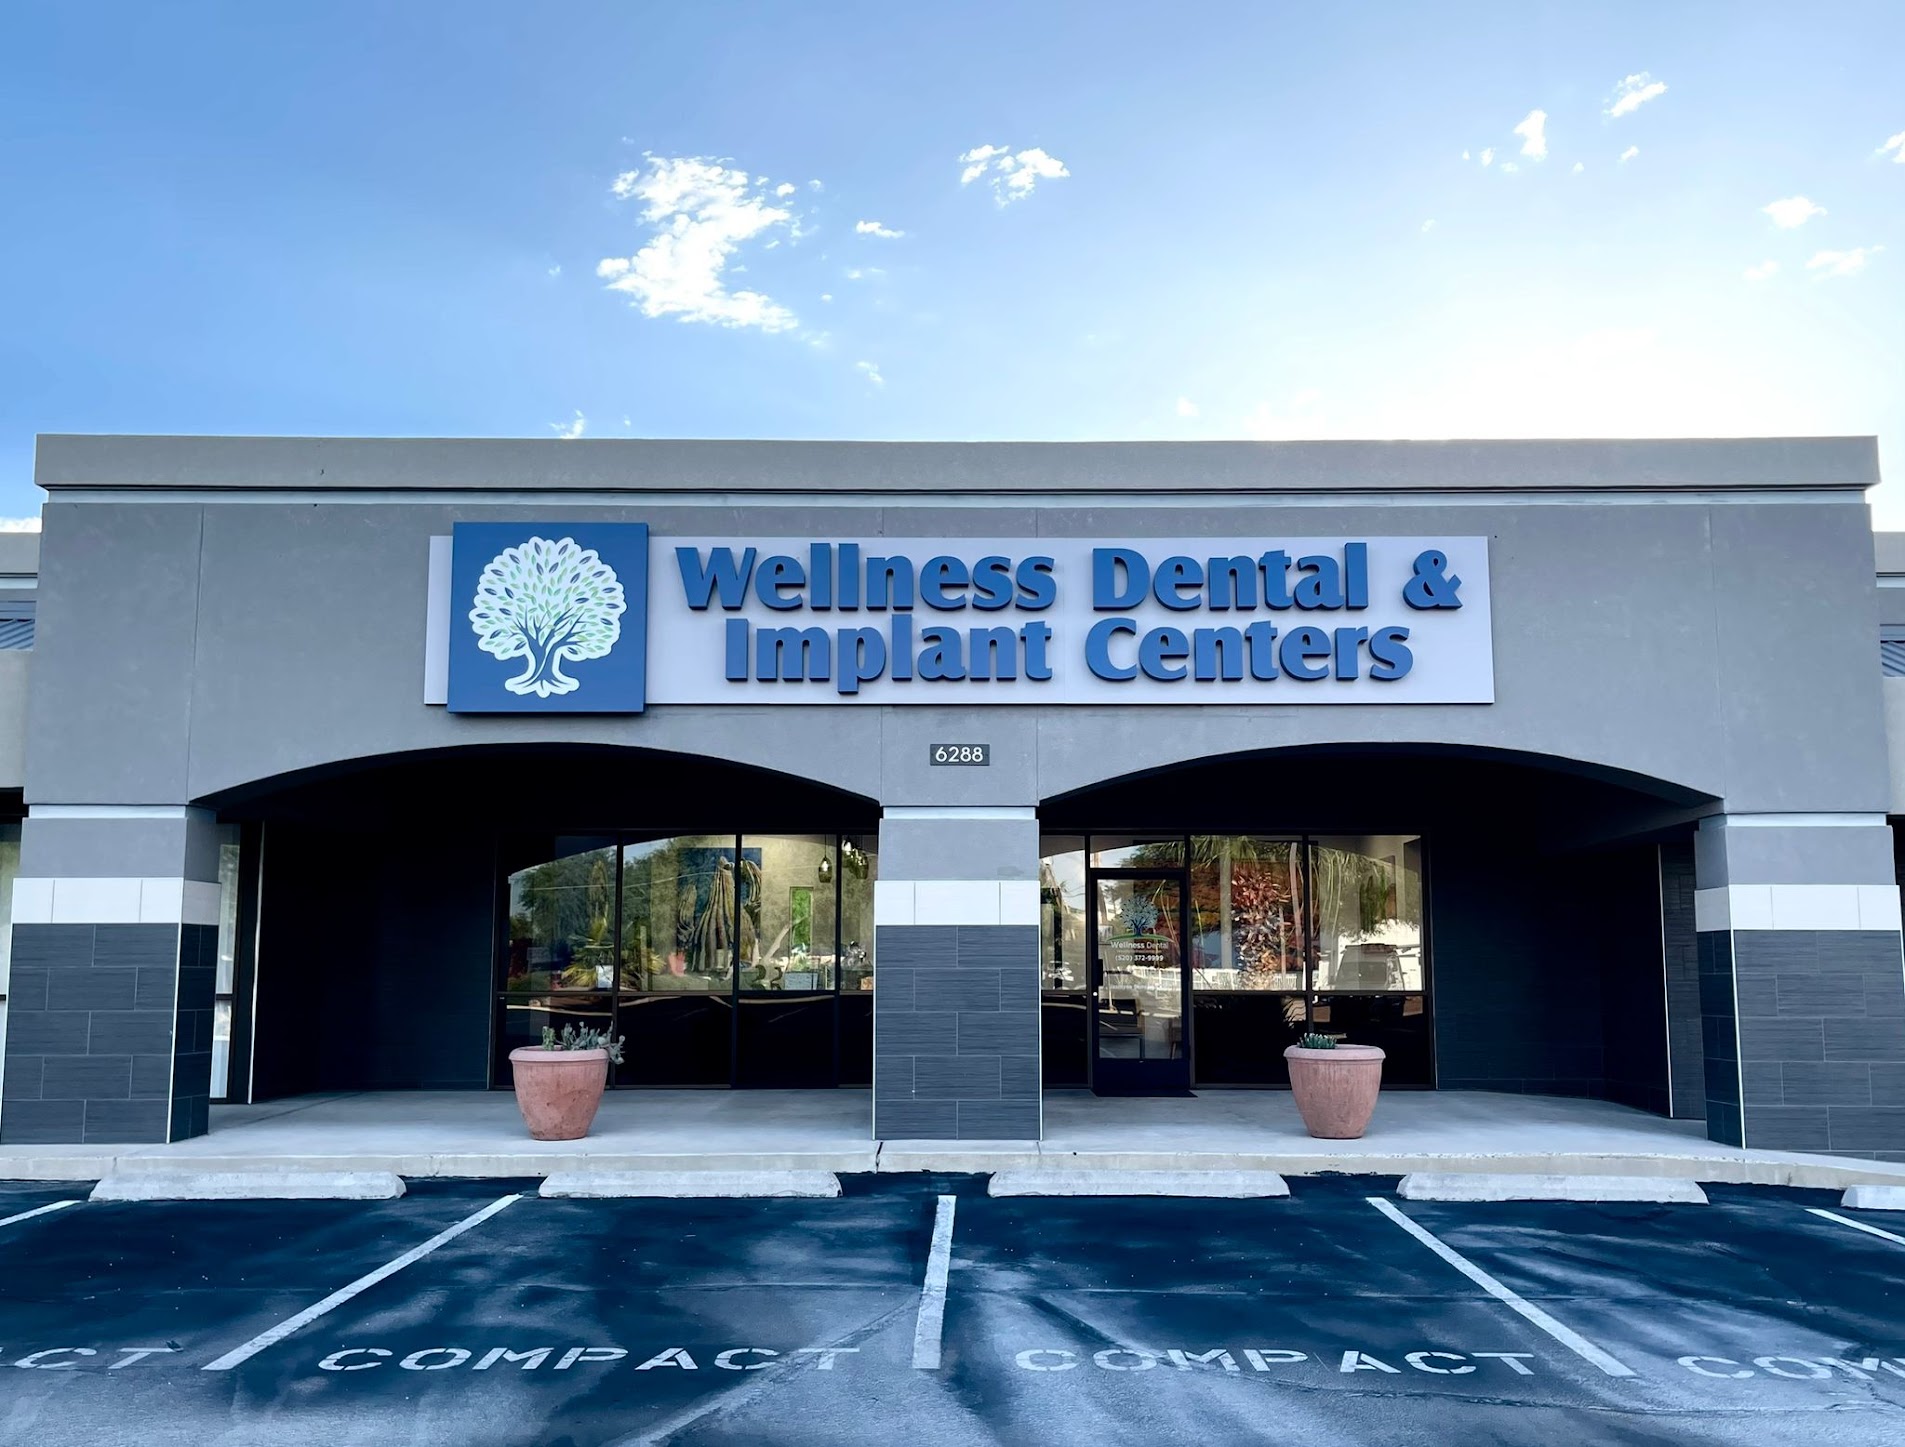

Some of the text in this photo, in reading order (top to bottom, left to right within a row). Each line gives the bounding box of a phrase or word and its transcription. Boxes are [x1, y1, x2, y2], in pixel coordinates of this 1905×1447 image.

[675, 542, 1463, 611] Wellness Dental &
[725, 613, 1414, 695] Implant Centers
[935, 746, 984, 763] 6288
[1110, 941, 1169, 949] Wellness Dental
[0, 1346, 184, 1370] CT
[318, 1347, 860, 1371] COMPACT
[1015, 1348, 1534, 1375] COMPACT
[1677, 1355, 1905, 1380] COM
